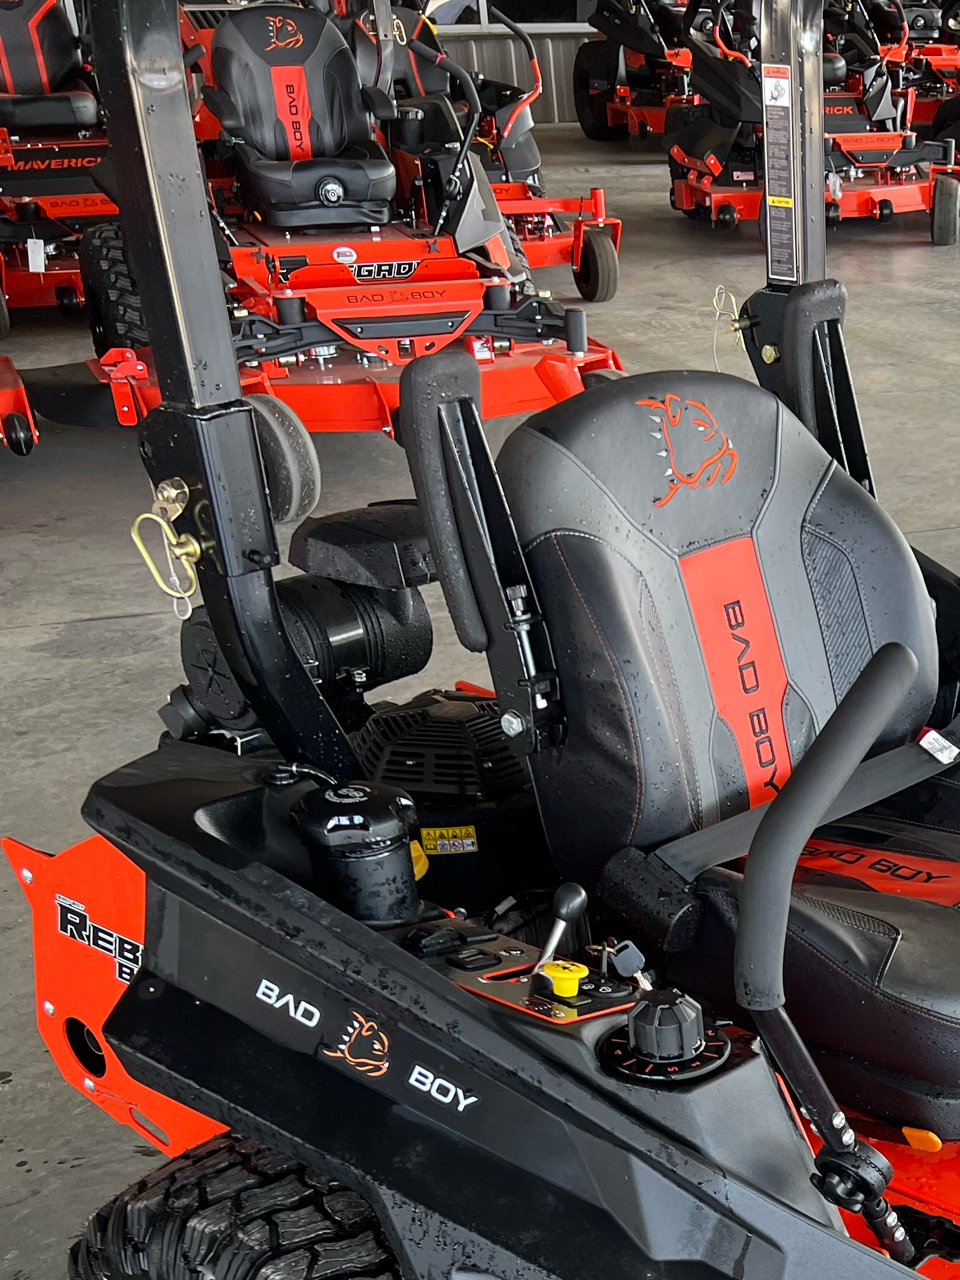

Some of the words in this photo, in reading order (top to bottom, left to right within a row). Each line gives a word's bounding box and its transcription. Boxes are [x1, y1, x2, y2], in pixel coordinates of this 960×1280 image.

[286, 84, 299, 116] BAD
[291, 120, 305, 152] BOY
[346, 293, 385, 304] BAD
[410, 289, 447, 300] BOY
[724, 599, 760, 695] BAD
[748, 706, 780, 795] BOY
[799, 846, 866, 865] BAD
[867, 858, 952, 883] BOY
[54, 899, 145, 968] REB
[255, 978, 321, 1027] BAD
[408, 1064, 479, 1112] BOY
